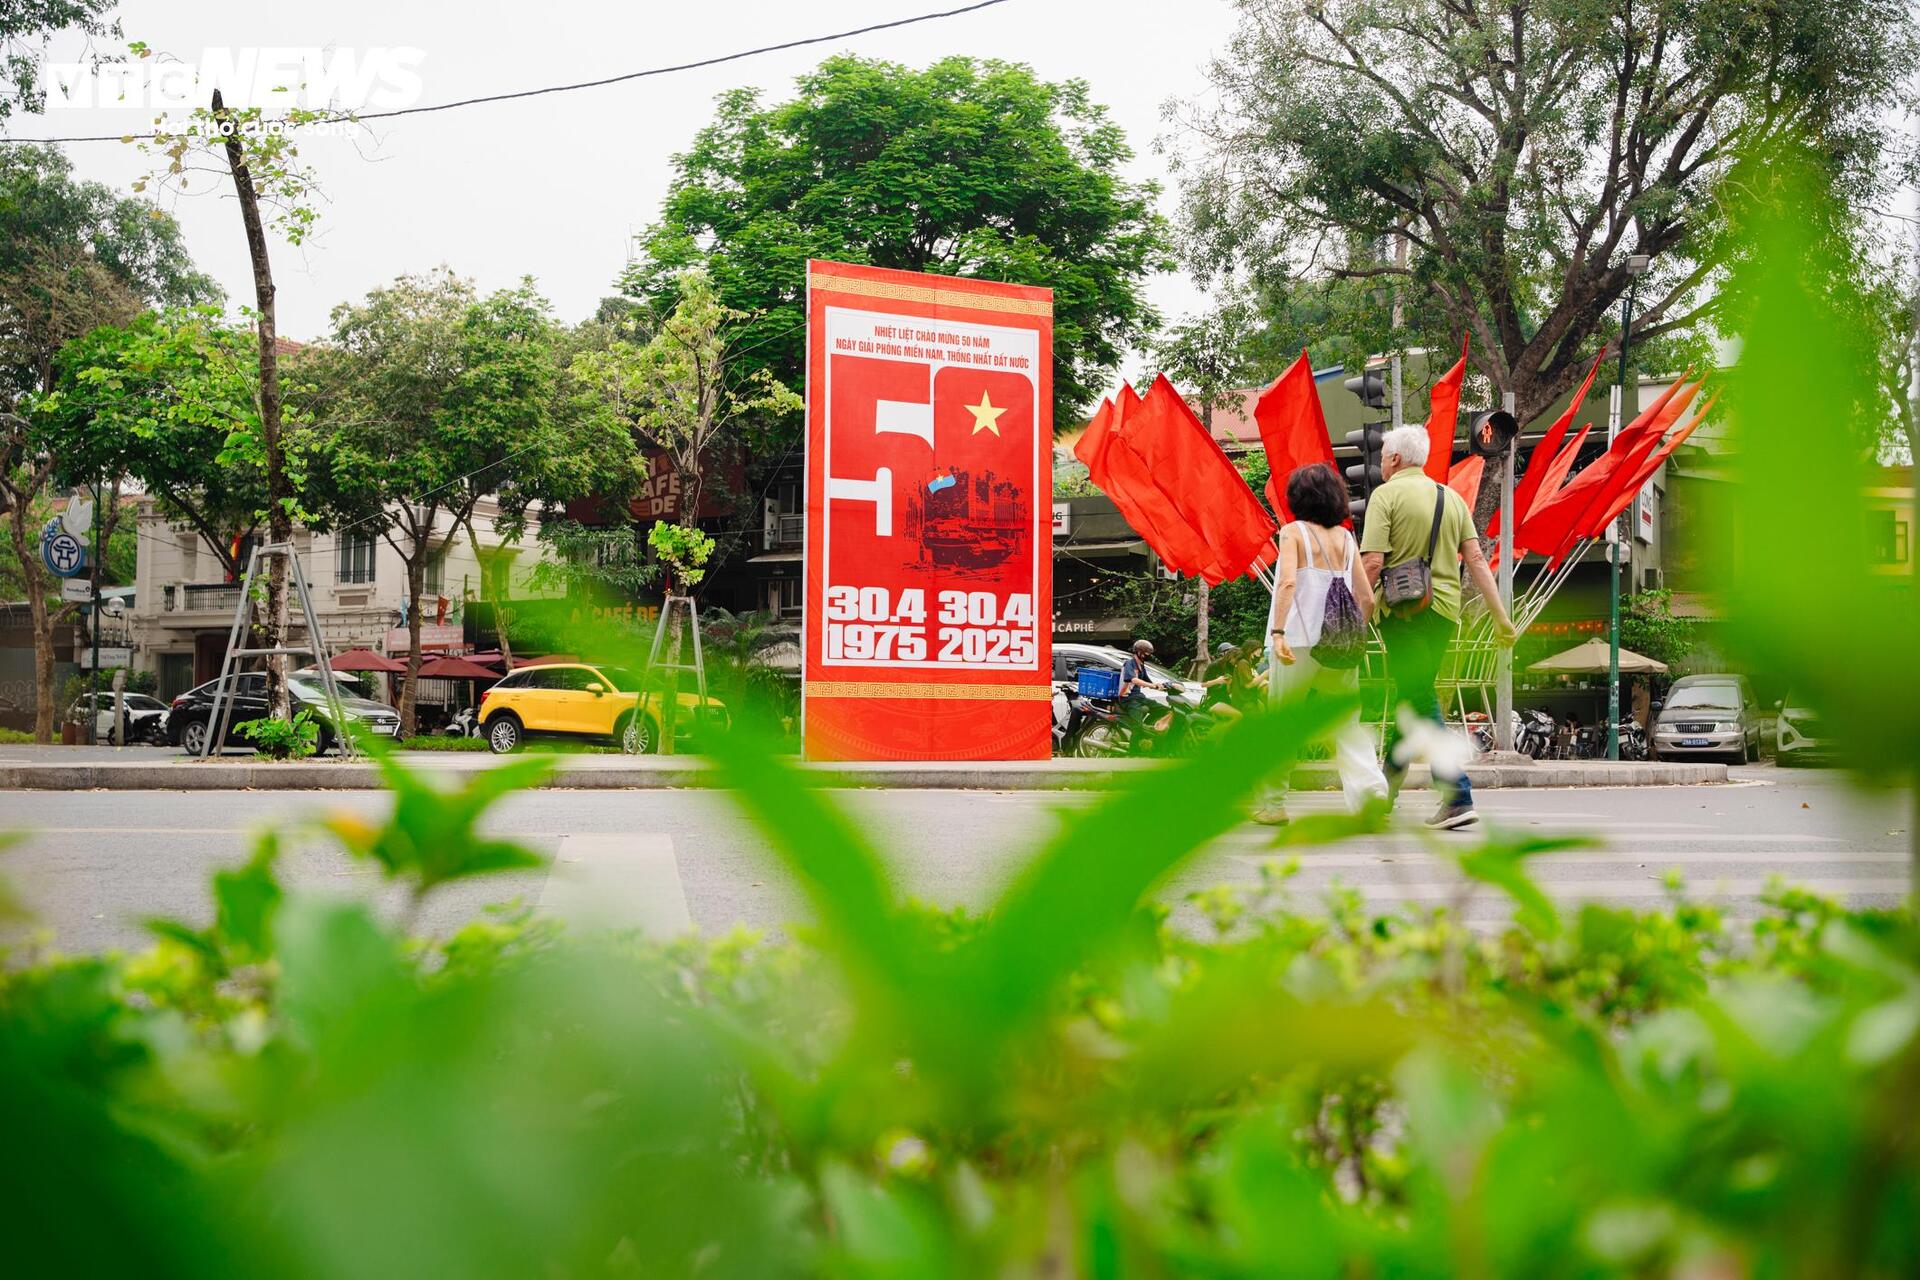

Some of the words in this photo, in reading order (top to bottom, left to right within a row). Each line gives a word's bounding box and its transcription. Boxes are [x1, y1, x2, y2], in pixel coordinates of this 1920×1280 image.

[836, 336, 857, 351] NGÀY
[858, 337, 874, 353] GIẢI
[876, 341, 902, 357] PHÒNG
[947, 346, 971, 363] THỐNG
[973, 350, 992, 366] NHẤT
[993, 352, 1008, 367] ĐẤT
[1009, 354, 1030, 369] NƯỚC
[874, 325, 897, 341] NHIỆT
[898, 327, 914, 343] LIỆT
[915, 328, 937, 343] CHÀO
[937, 330, 960, 346] MỪNG
[962, 335, 971, 347] 50
[972, 335, 990, 349] NĂM
[650, 494, 677, 516] DE
[828, 585, 928, 623] 30.4
[938, 590, 1034, 627] 30.4
[828, 623, 927, 661] 1975
[937, 628, 1034, 664] 2025
